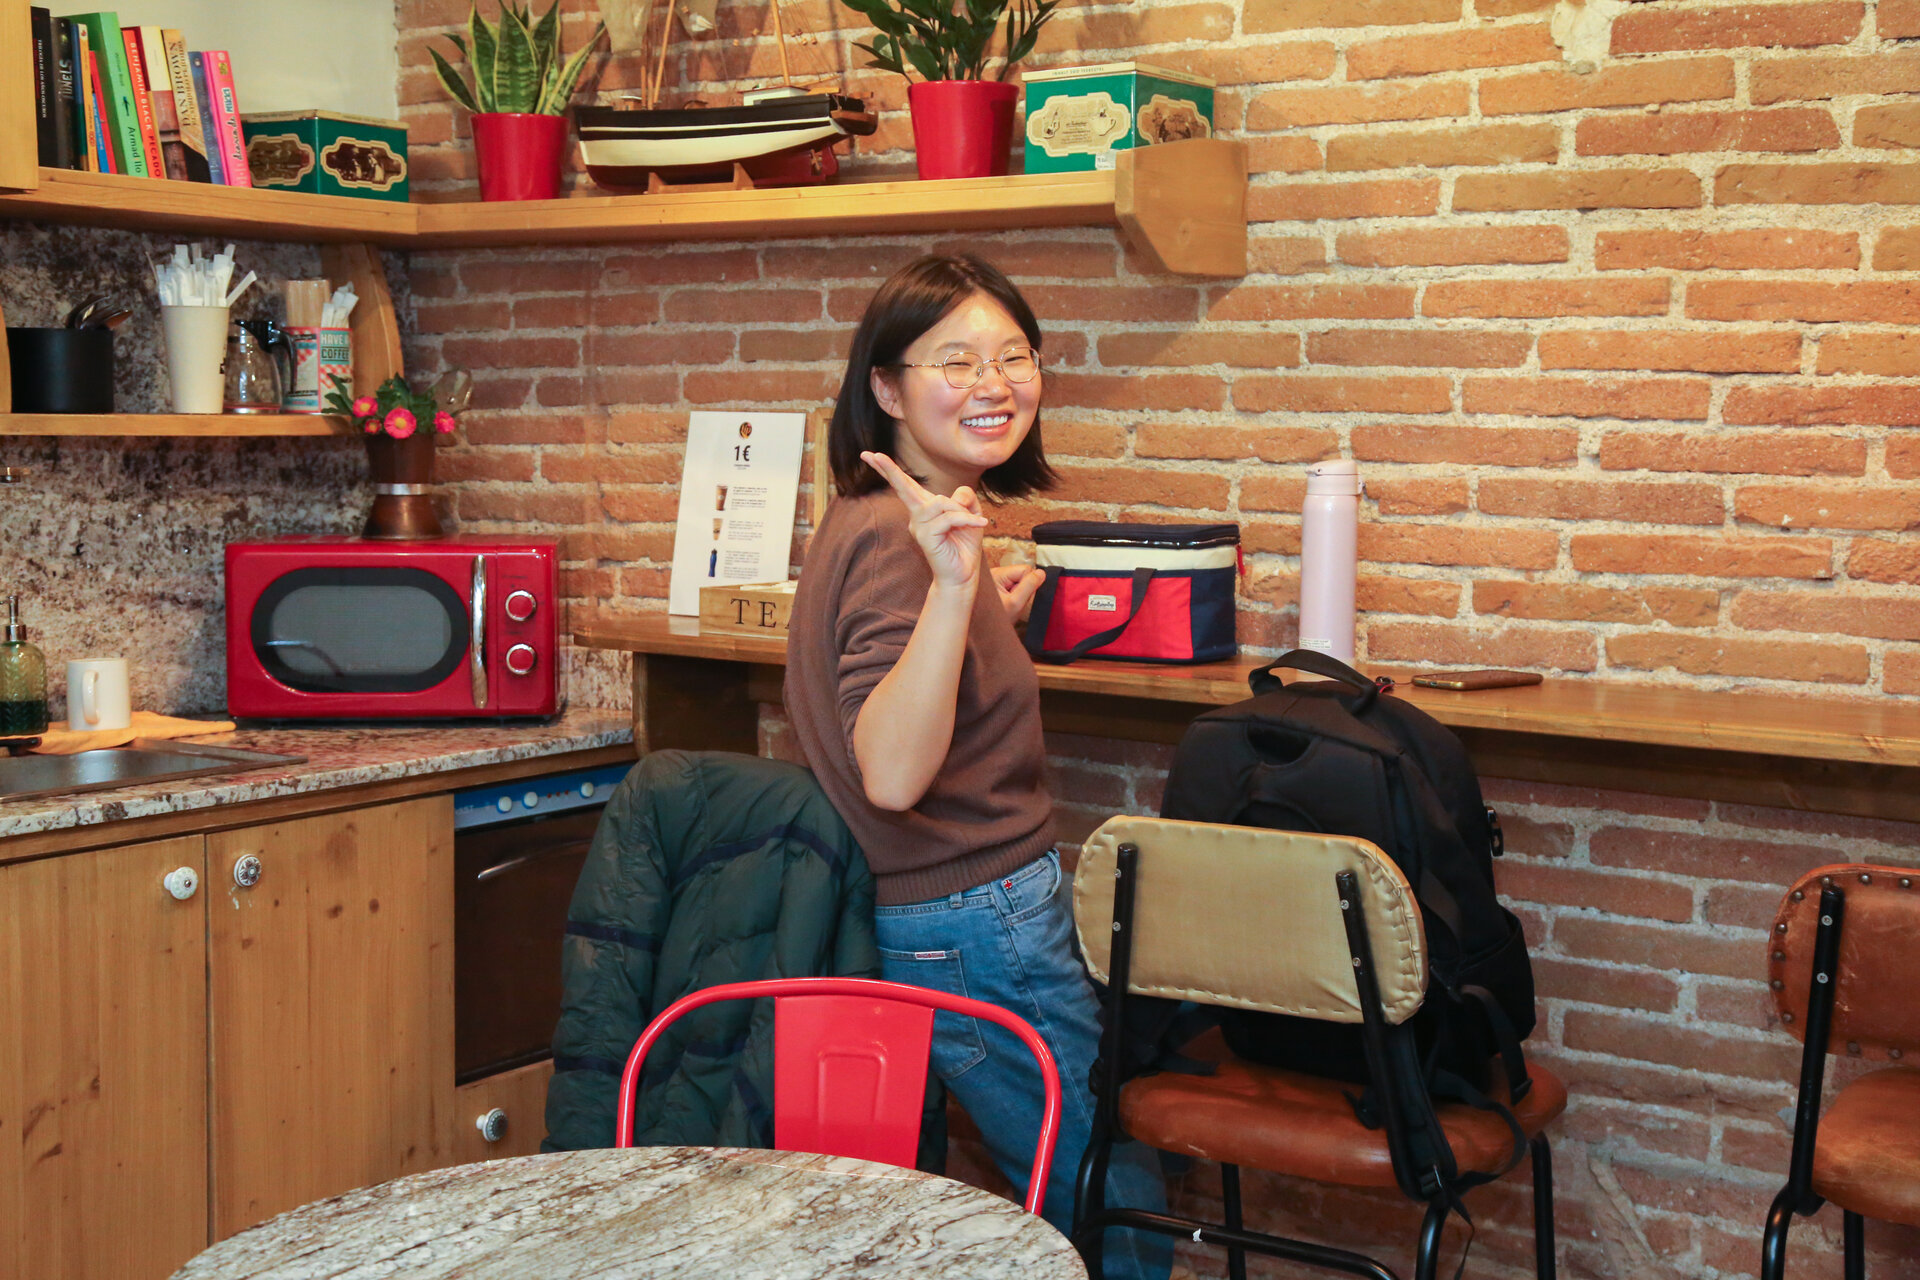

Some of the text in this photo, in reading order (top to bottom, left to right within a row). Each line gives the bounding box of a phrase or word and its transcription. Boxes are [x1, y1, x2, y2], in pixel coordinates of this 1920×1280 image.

[169, 41, 191, 127] DAN BROWN
[130, 42, 161, 178] BENJAMIN BLACK PECADO
[321, 333, 344, 345] HAVE
[321, 348, 350, 359] COFFEE
[734, 445, 751, 462] 1€
[730, 598, 792, 630] TE
